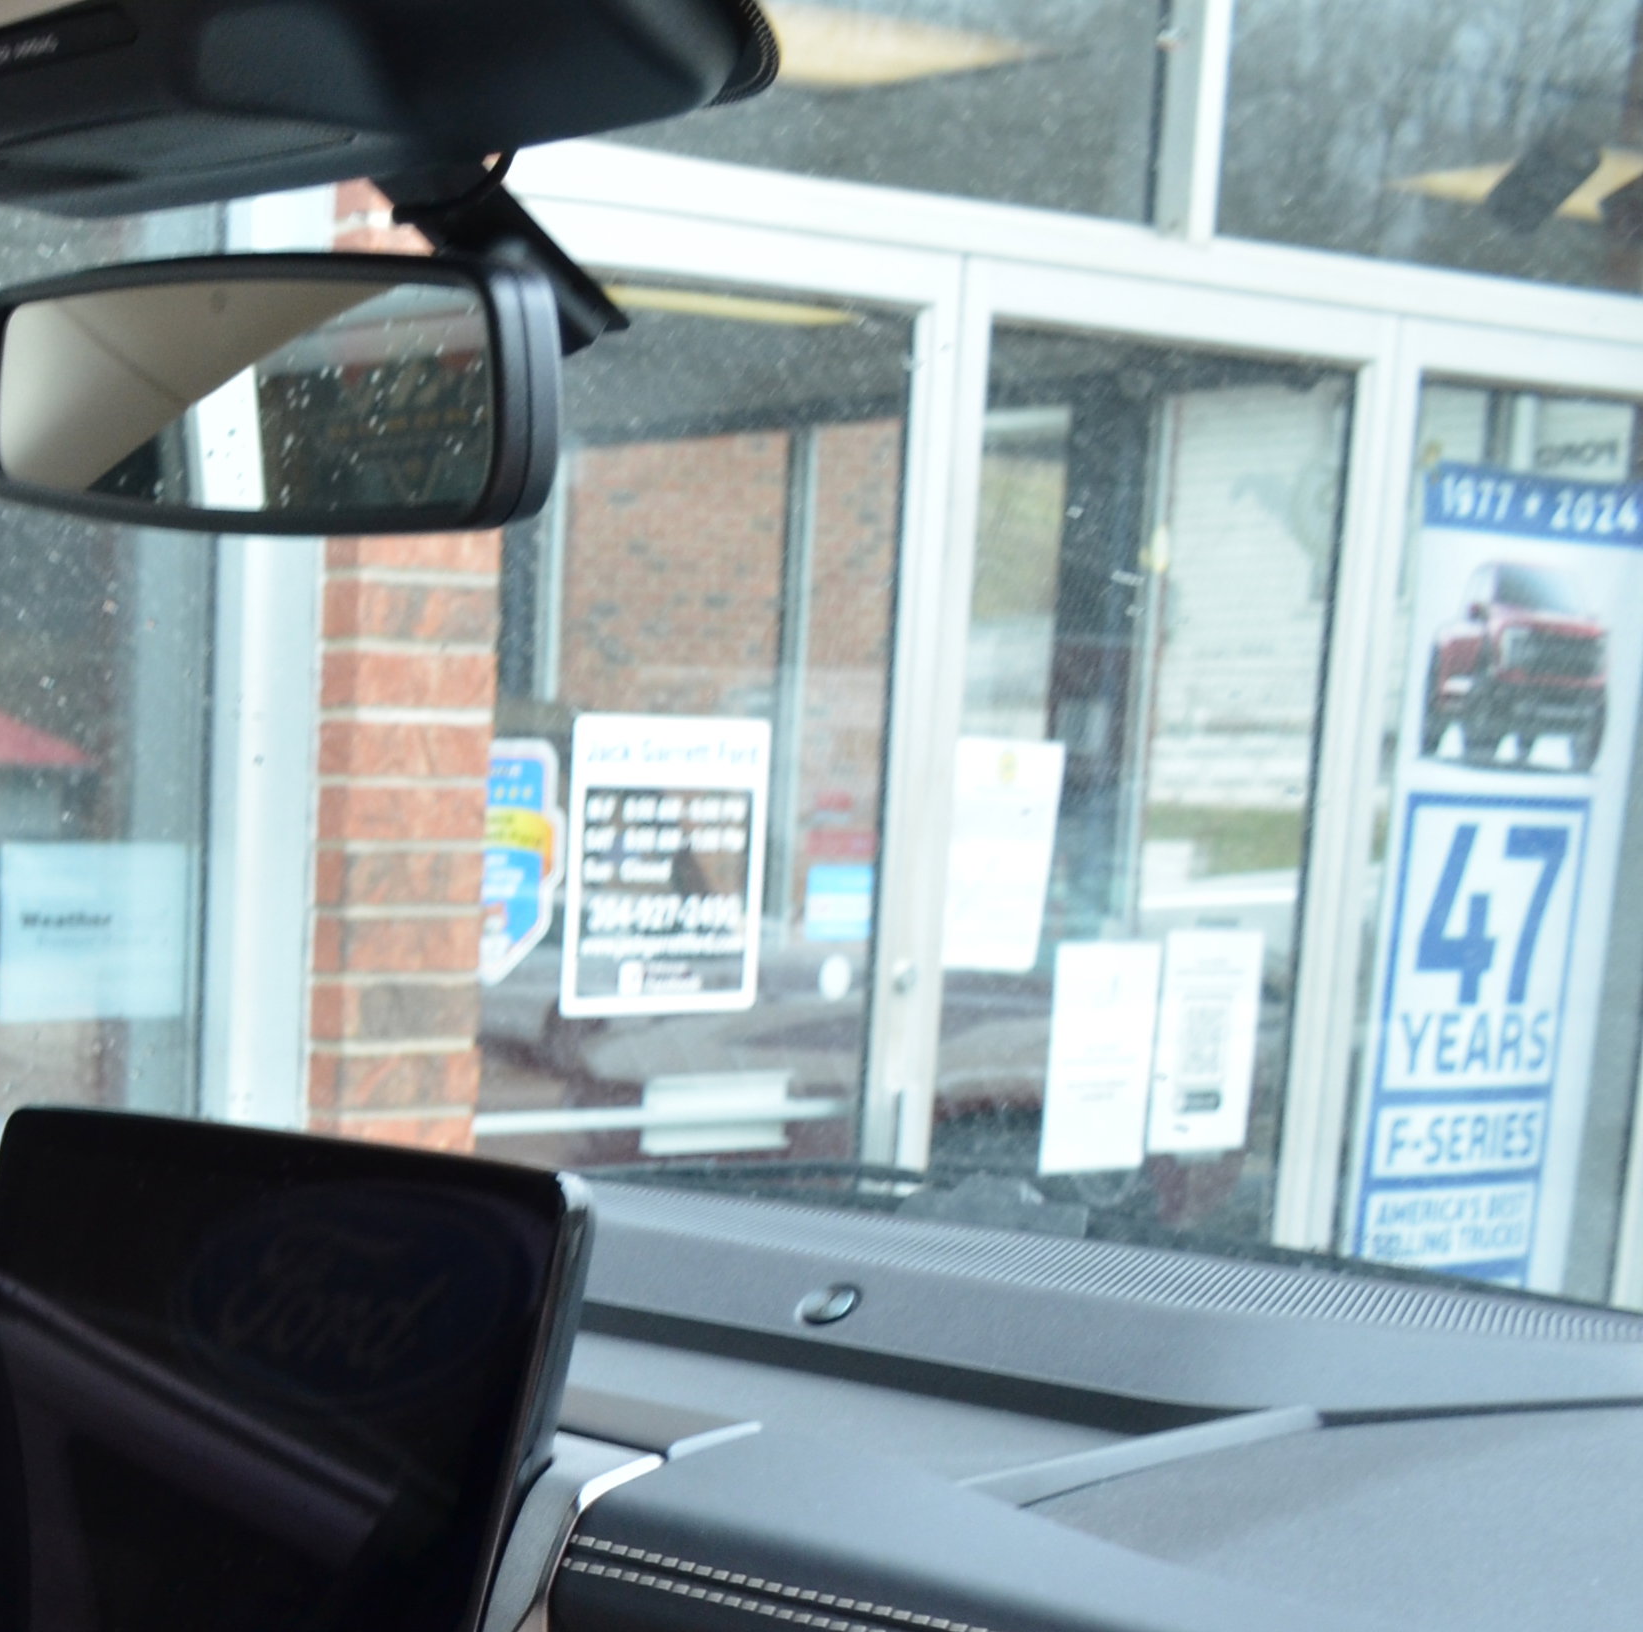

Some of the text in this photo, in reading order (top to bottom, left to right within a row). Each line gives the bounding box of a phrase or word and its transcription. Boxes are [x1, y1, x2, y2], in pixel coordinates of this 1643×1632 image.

[1442, 473, 1638, 534] 1977 2024
[1415, 822, 1571, 1006] 47
[1399, 1010, 1551, 1075] YEARS
[1386, 1110, 1538, 1168] F-SERIES
